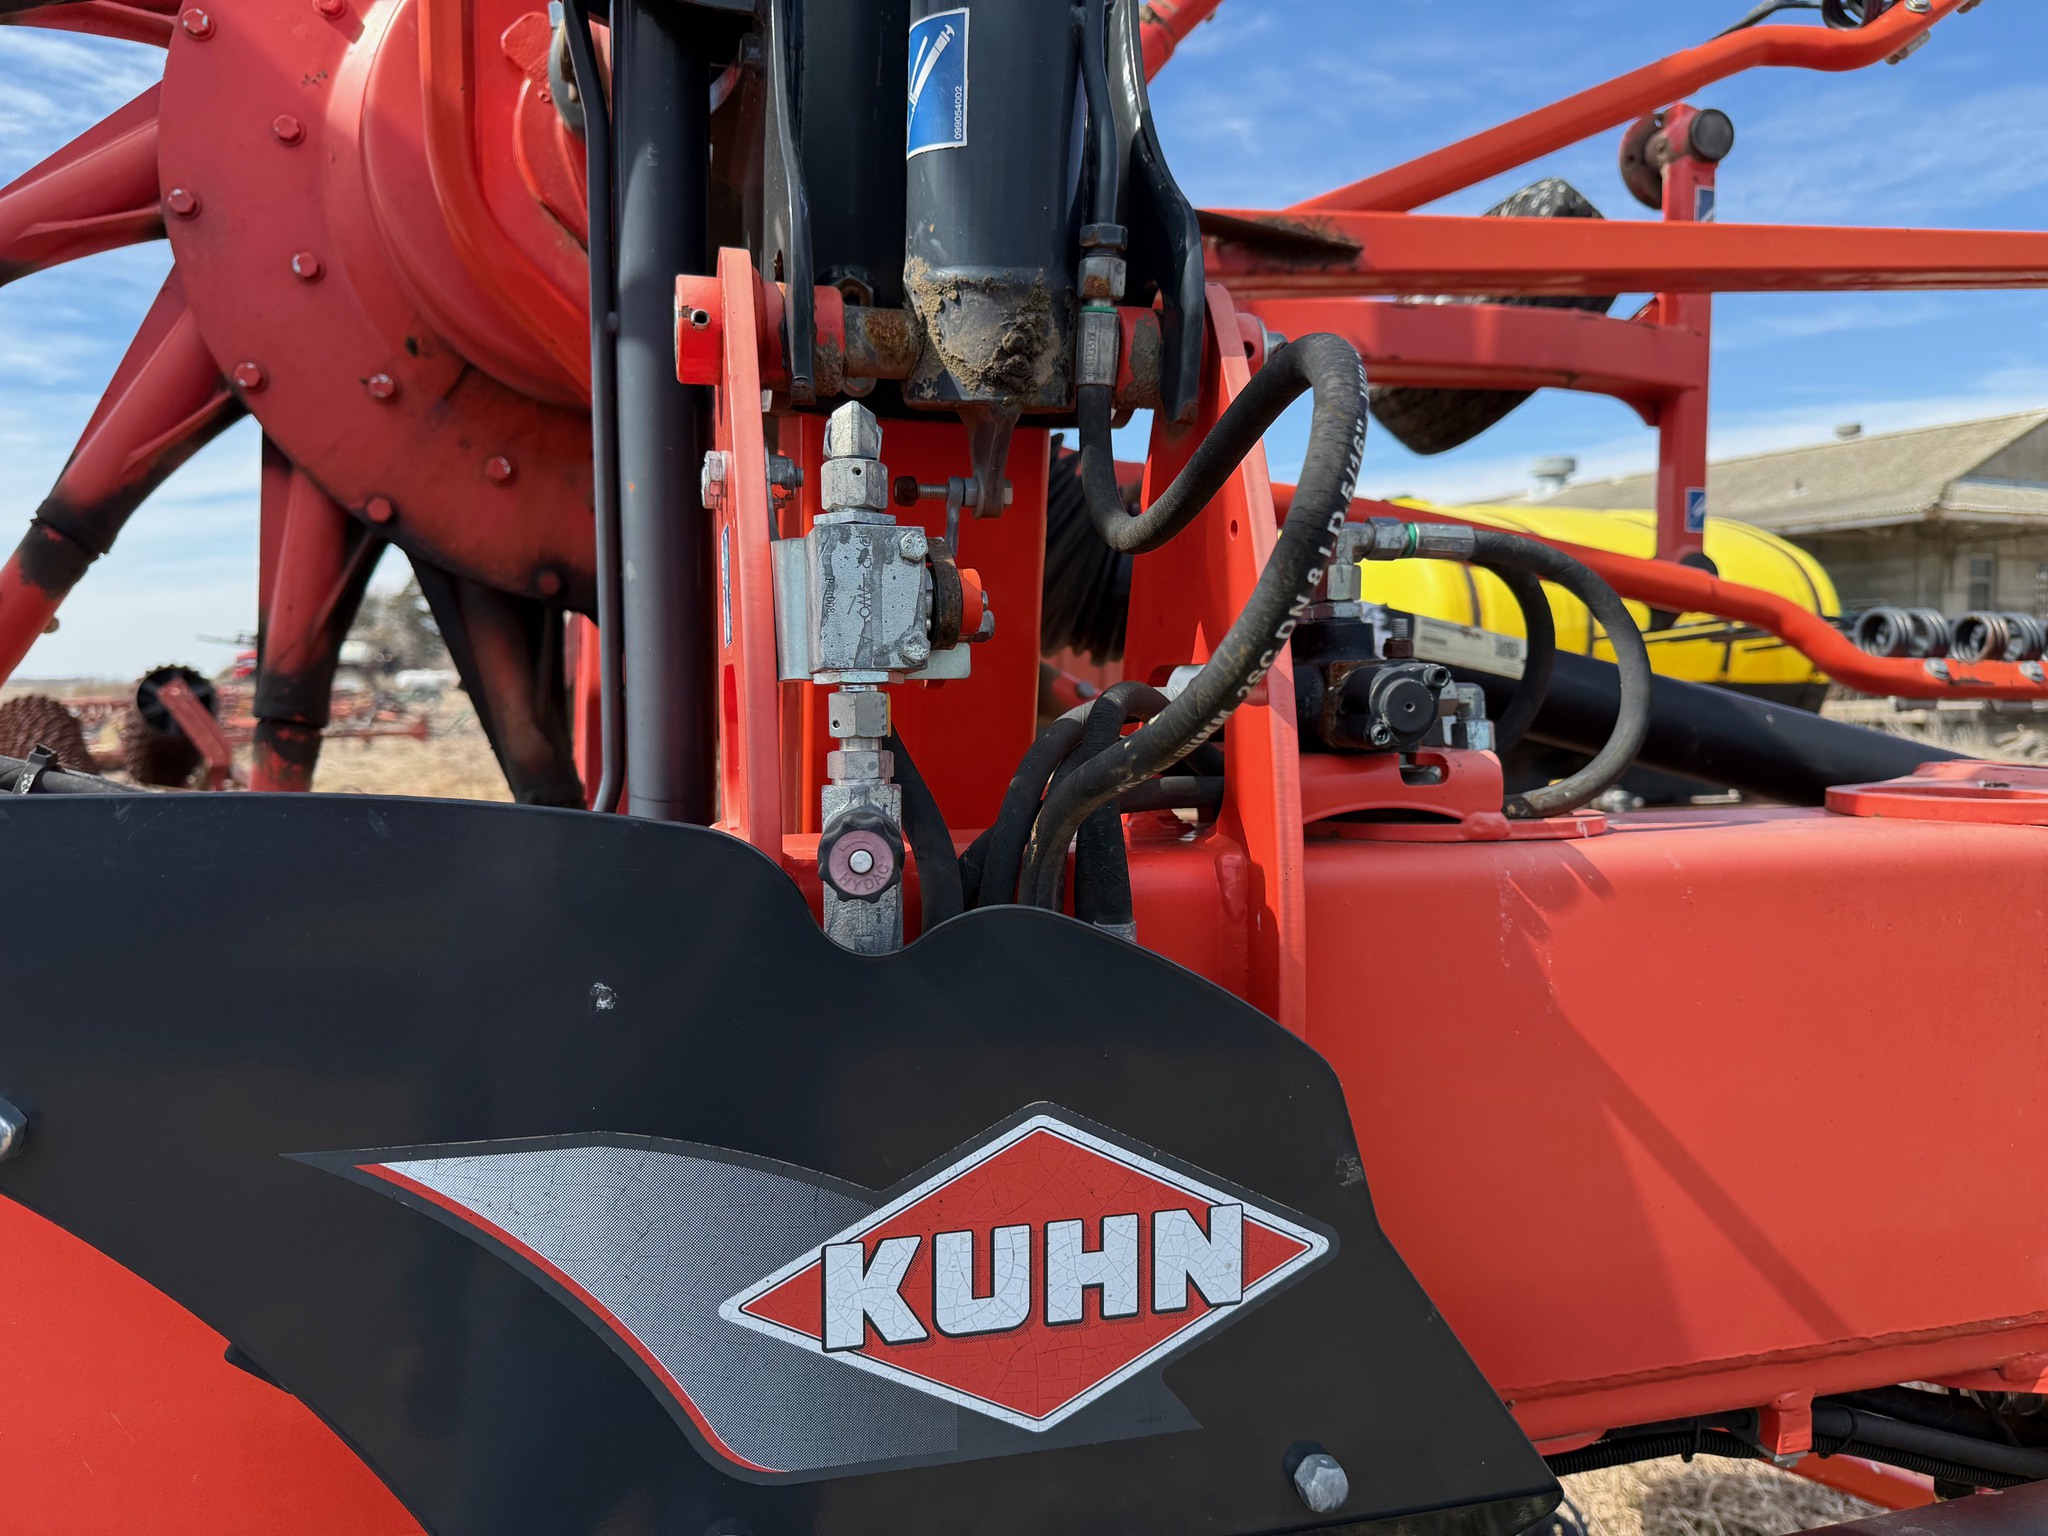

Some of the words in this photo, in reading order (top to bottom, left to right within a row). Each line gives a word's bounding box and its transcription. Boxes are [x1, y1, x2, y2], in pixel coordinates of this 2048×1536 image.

[954, 86, 963, 140] 099054002
[1275, 594, 1311, 639] DN
[1307, 567, 1324, 587] 8
[838, 864, 889, 891] HYDAC
[821, 1203, 1245, 1353] KUHN
